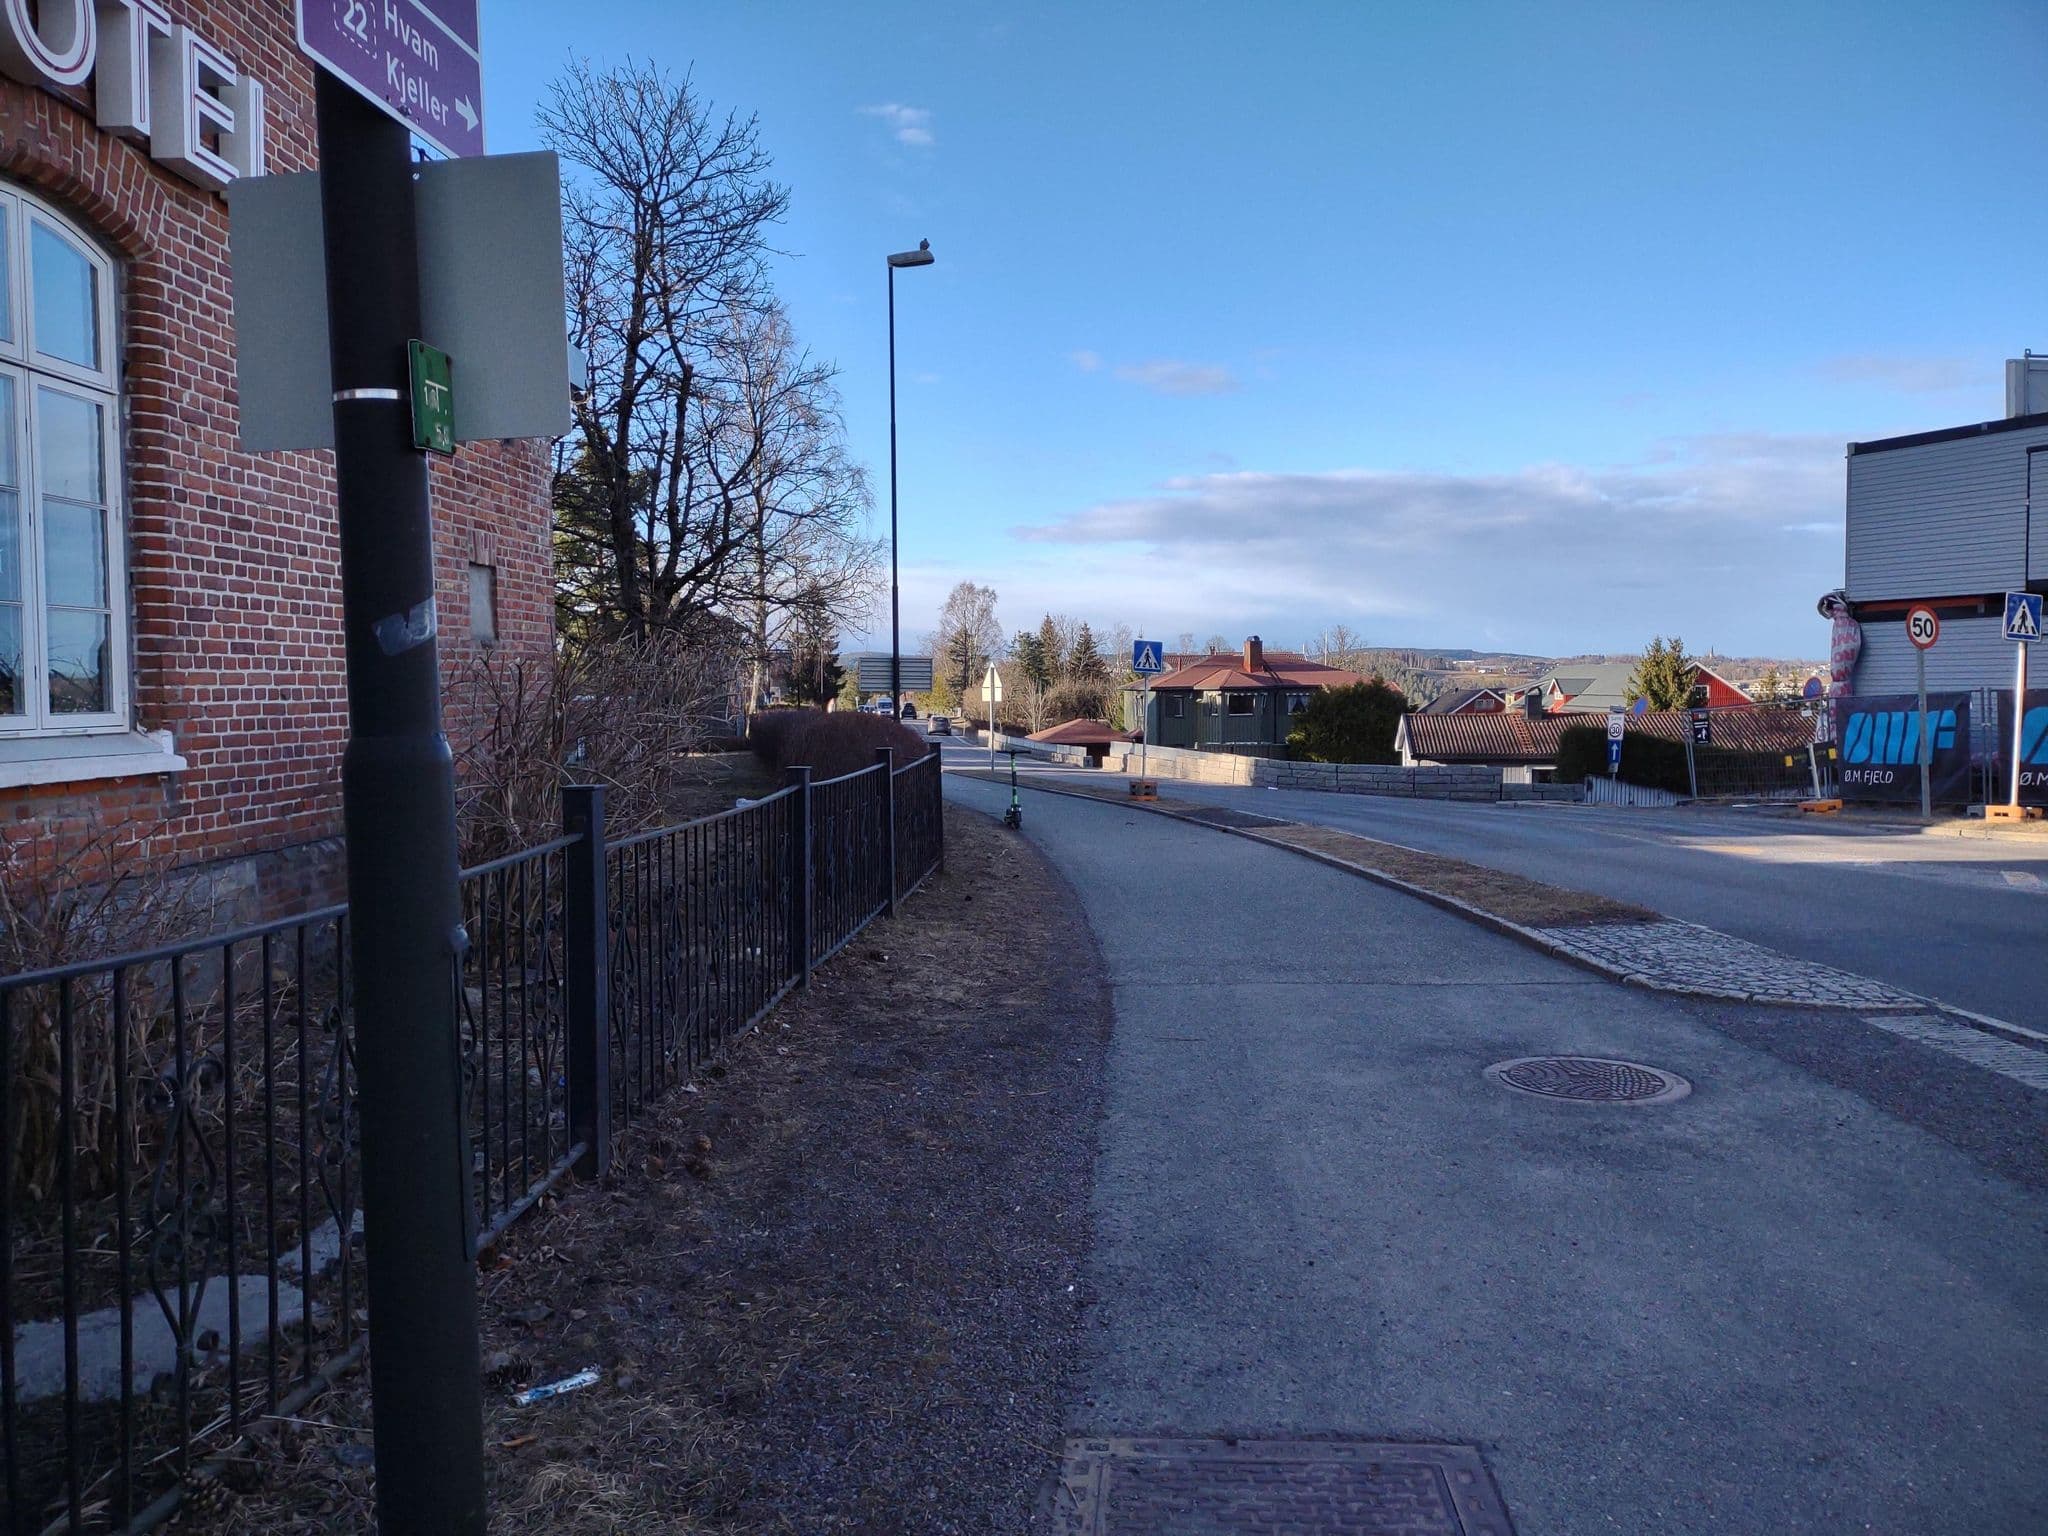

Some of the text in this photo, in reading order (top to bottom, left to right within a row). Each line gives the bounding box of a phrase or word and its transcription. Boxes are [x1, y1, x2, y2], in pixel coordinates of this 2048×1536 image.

[343, 0, 368, 42] 22
[384, 0, 439, 72] Hvam
[386, 51, 449, 126] Kjeller
[1912, 616, 1934, 639] 50
[1611, 726, 1620, 735] 30
[1863, 770, 1894, 786] FJELD
